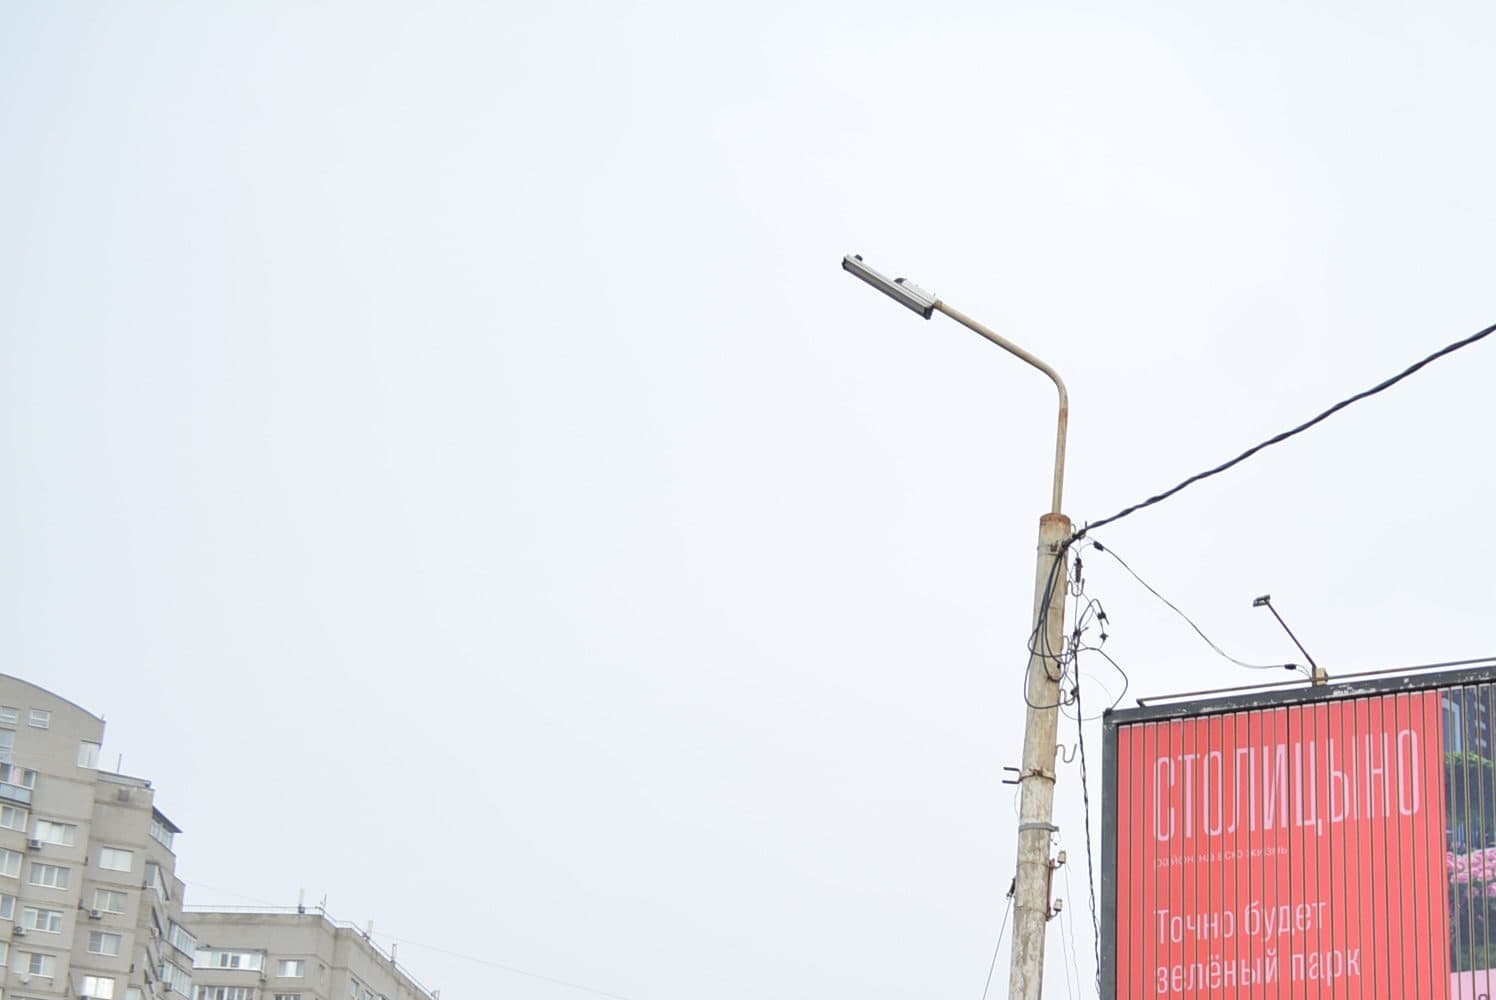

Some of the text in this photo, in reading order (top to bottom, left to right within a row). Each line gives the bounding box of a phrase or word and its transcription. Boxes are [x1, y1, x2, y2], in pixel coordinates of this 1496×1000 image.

[1153, 729, 1420, 841] СТОЛИЦЫНО
[1153, 900, 1326, 945] Точно будет
[1155, 948, 1361, 994] зелёный парк
